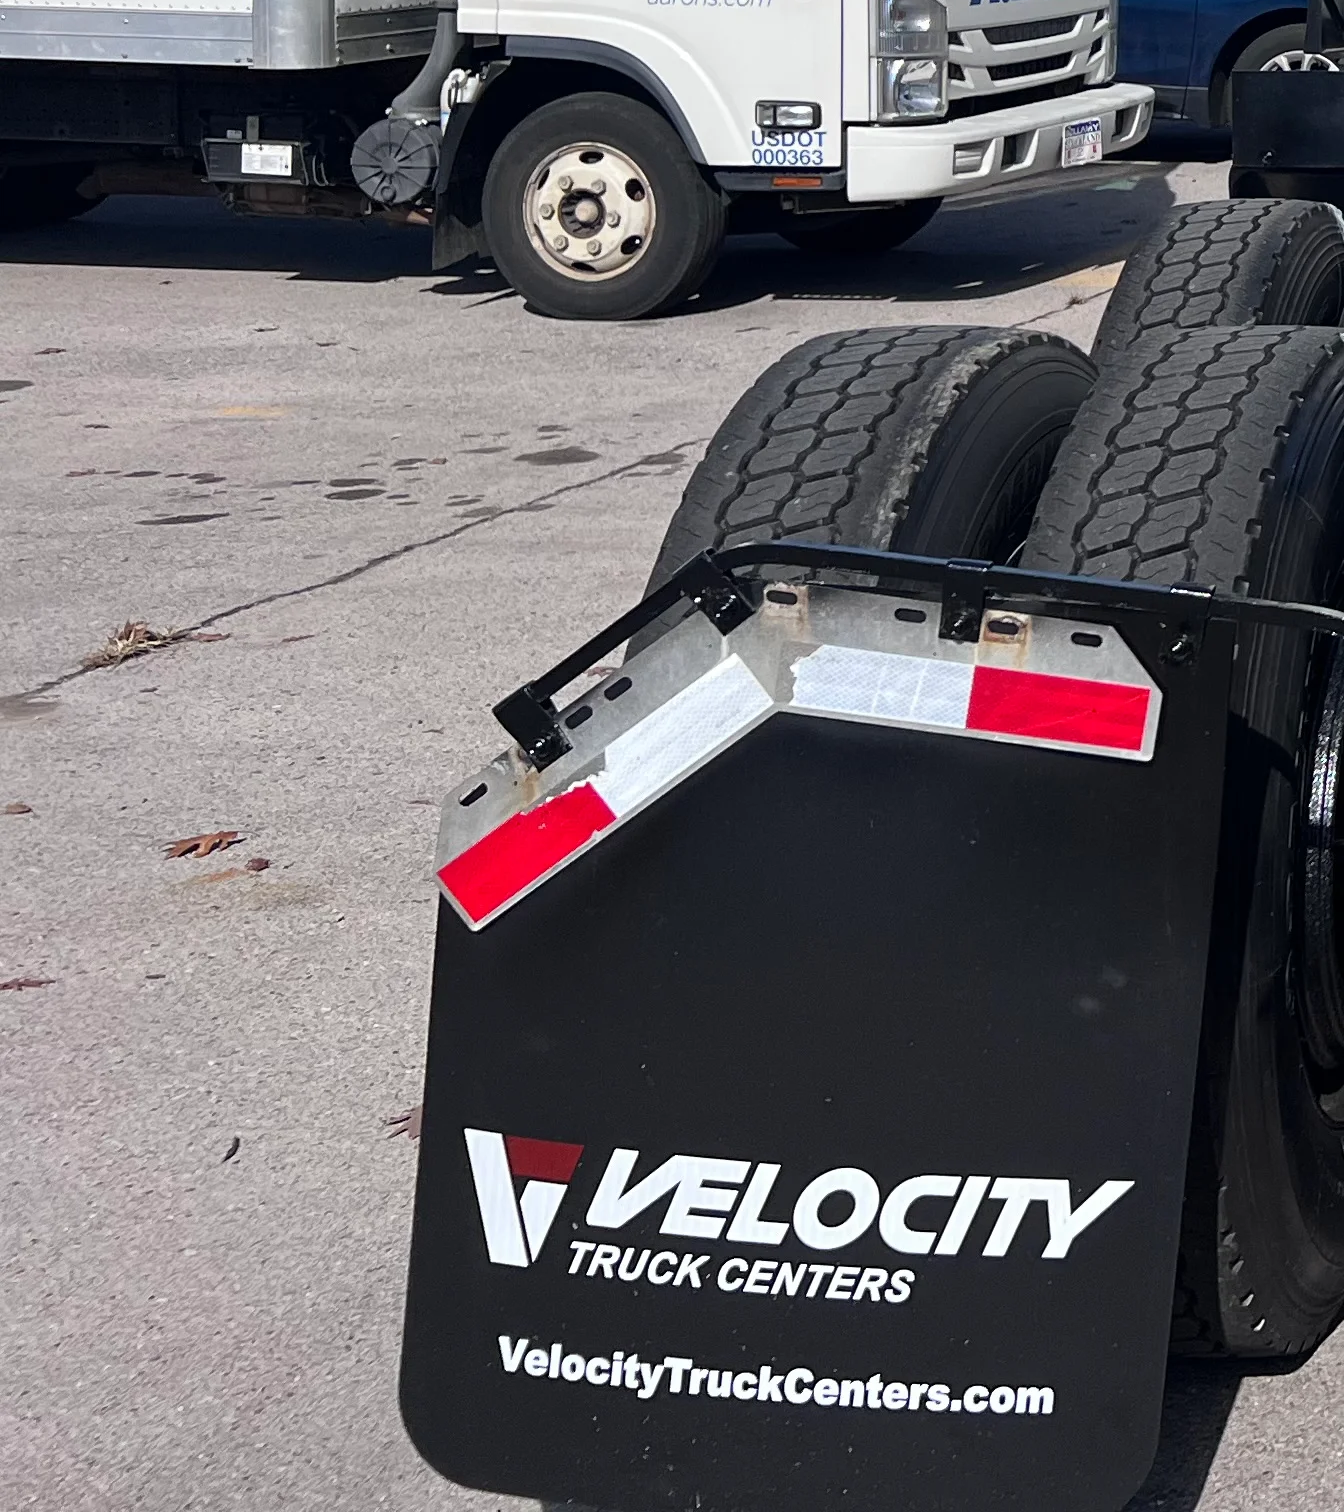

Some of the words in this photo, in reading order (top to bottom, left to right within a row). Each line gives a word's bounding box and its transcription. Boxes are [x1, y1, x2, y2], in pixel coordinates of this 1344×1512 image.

[751, 130, 827, 147] USDOT
[752, 149, 823, 165] 000363
[586, 1148, 1135, 1259] VELOCITY
[567, 1241, 711, 1288] TRUCK
[717, 1257, 916, 1303] CENTERS
[499, 1335, 1055, 1414] VelocityTruckCenters.com
